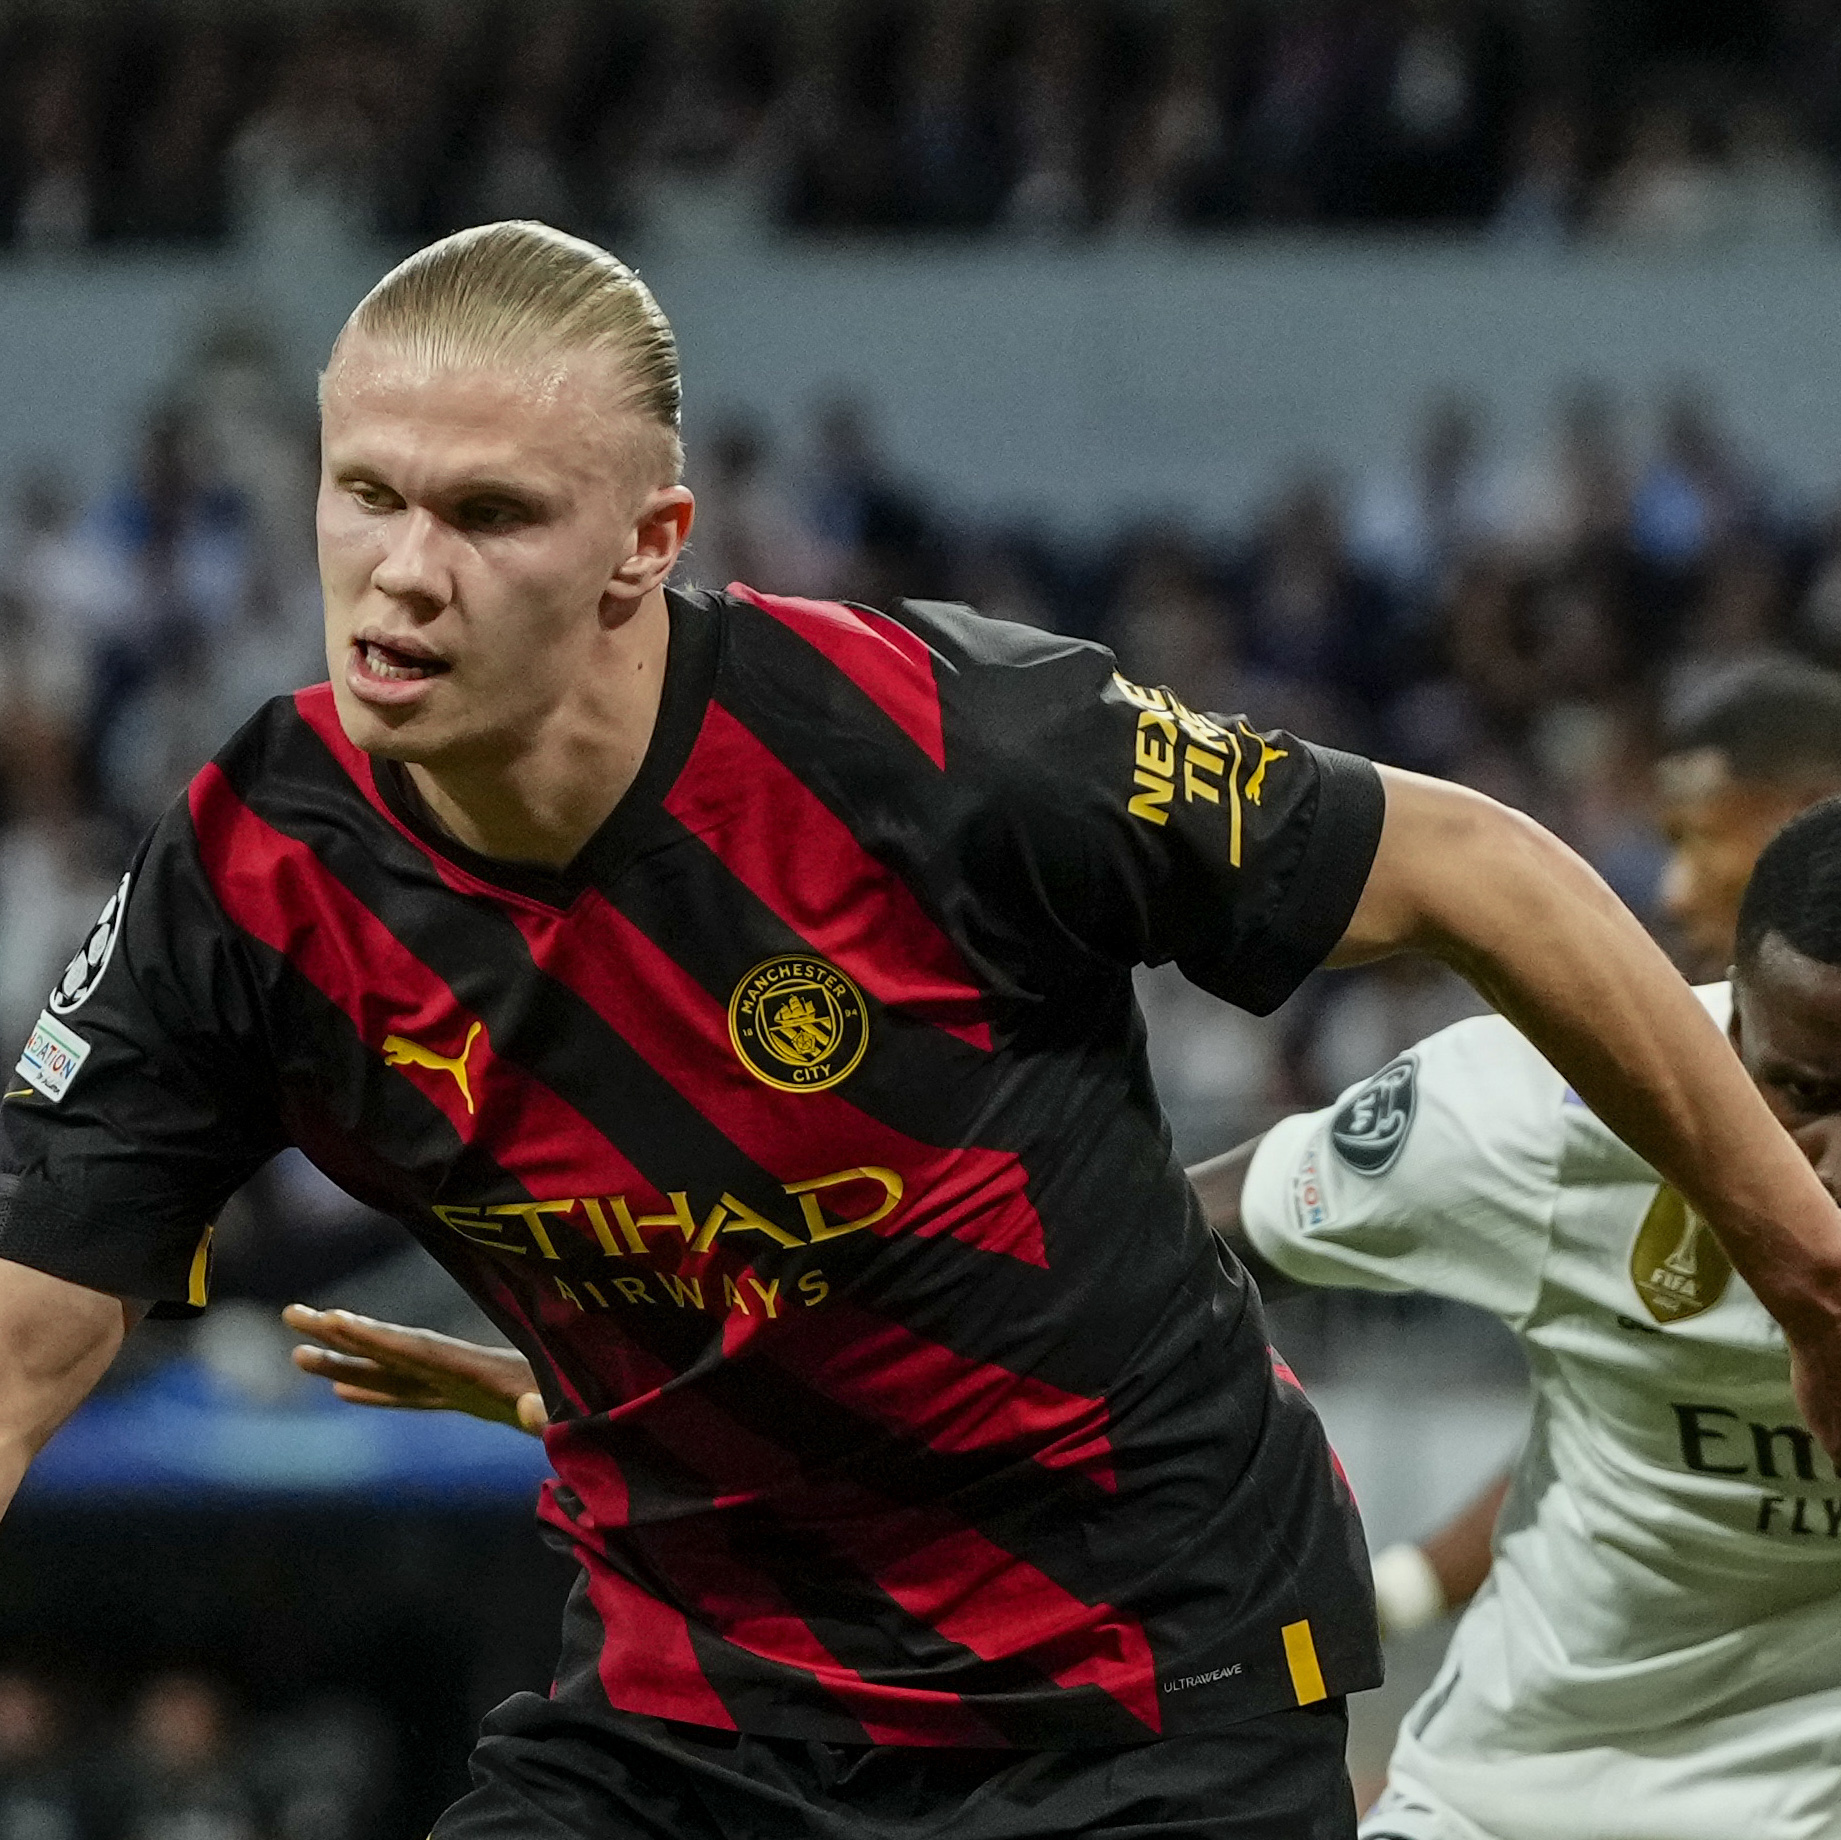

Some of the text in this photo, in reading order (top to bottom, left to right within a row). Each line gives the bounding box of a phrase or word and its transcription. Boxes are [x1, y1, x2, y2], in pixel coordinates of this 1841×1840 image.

[1112, 672, 1178, 826] NEXE
[741, 963, 847, 1014] MANCHESTER
[26, 1033, 77, 1080] NDATION
[792, 1063, 831, 1082] CITY
[431, 1165, 904, 1260] ETIHAD
[553, 1268, 831, 1320] AIRWAYS
[1650, 1267, 1697, 1297] FIFA
[1163, 1662, 1243, 1694] ULTRAWEAVE
